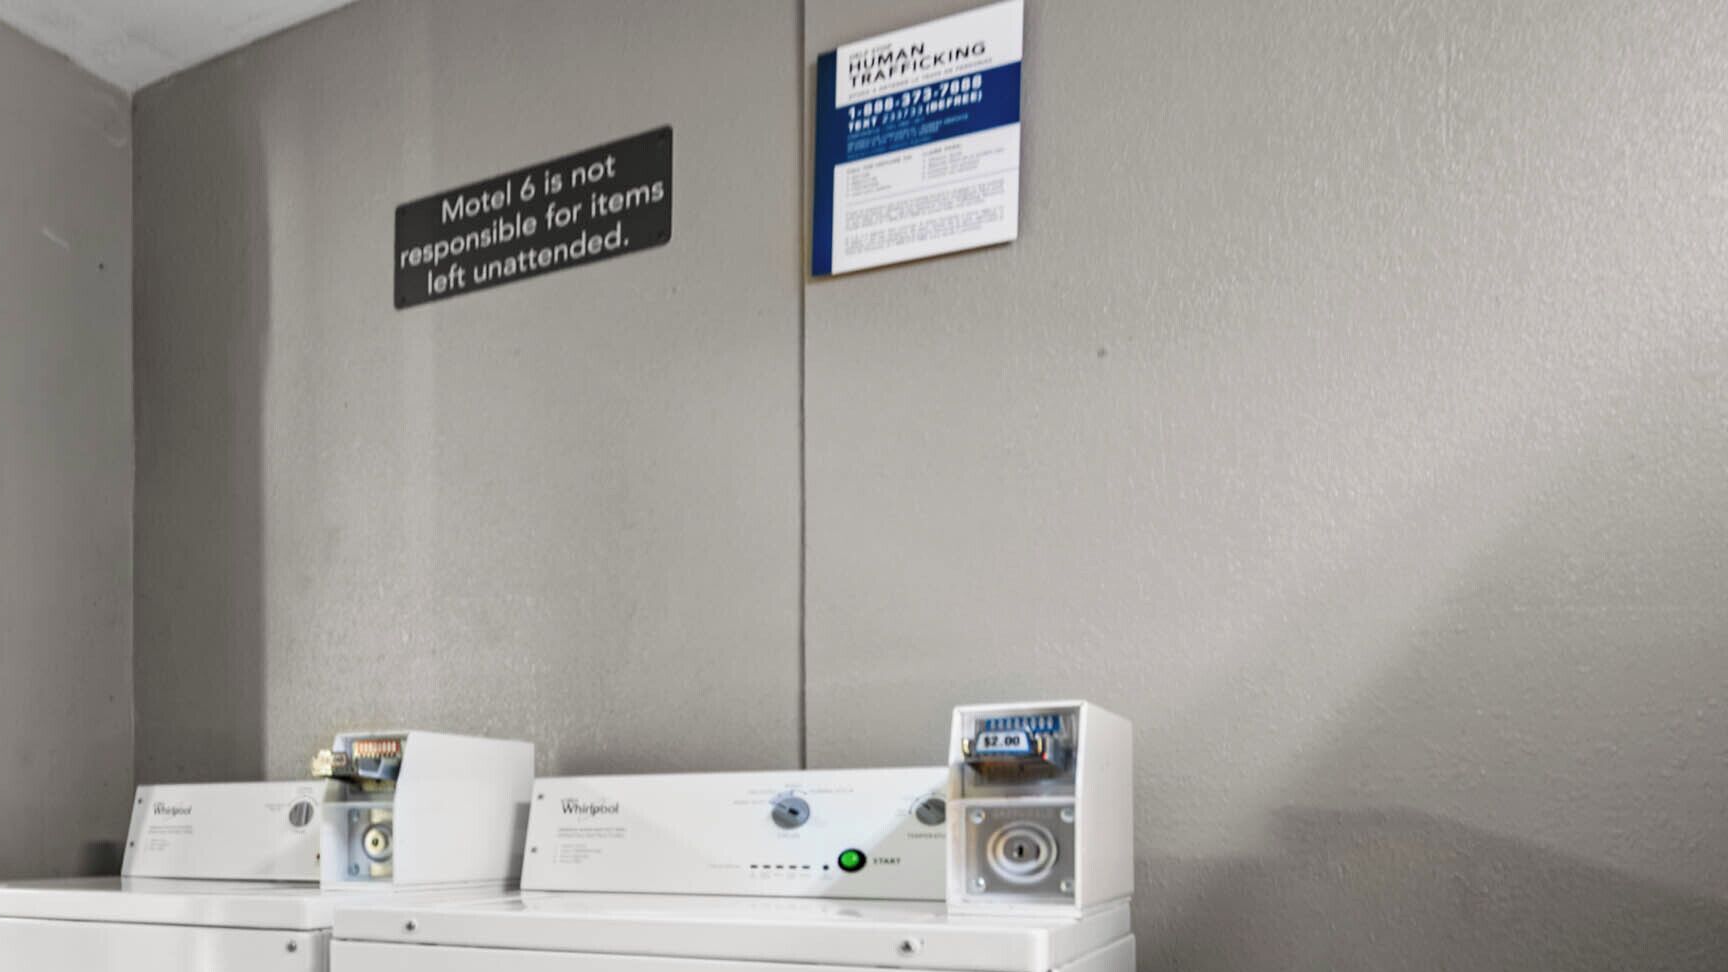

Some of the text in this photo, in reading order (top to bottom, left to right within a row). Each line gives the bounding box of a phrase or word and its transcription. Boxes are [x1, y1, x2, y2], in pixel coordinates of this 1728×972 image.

[849, 42, 924, 74] HUMAN
[849, 41, 986, 88] TRAFFICKING
[441, 154, 616, 224] Motel 6 is not
[400, 180, 664, 269] responsible for items
[427, 222, 629, 296] left unattended.
[983, 735, 1020, 748] $2.00
[560, 798, 620, 816] Whirlpool
